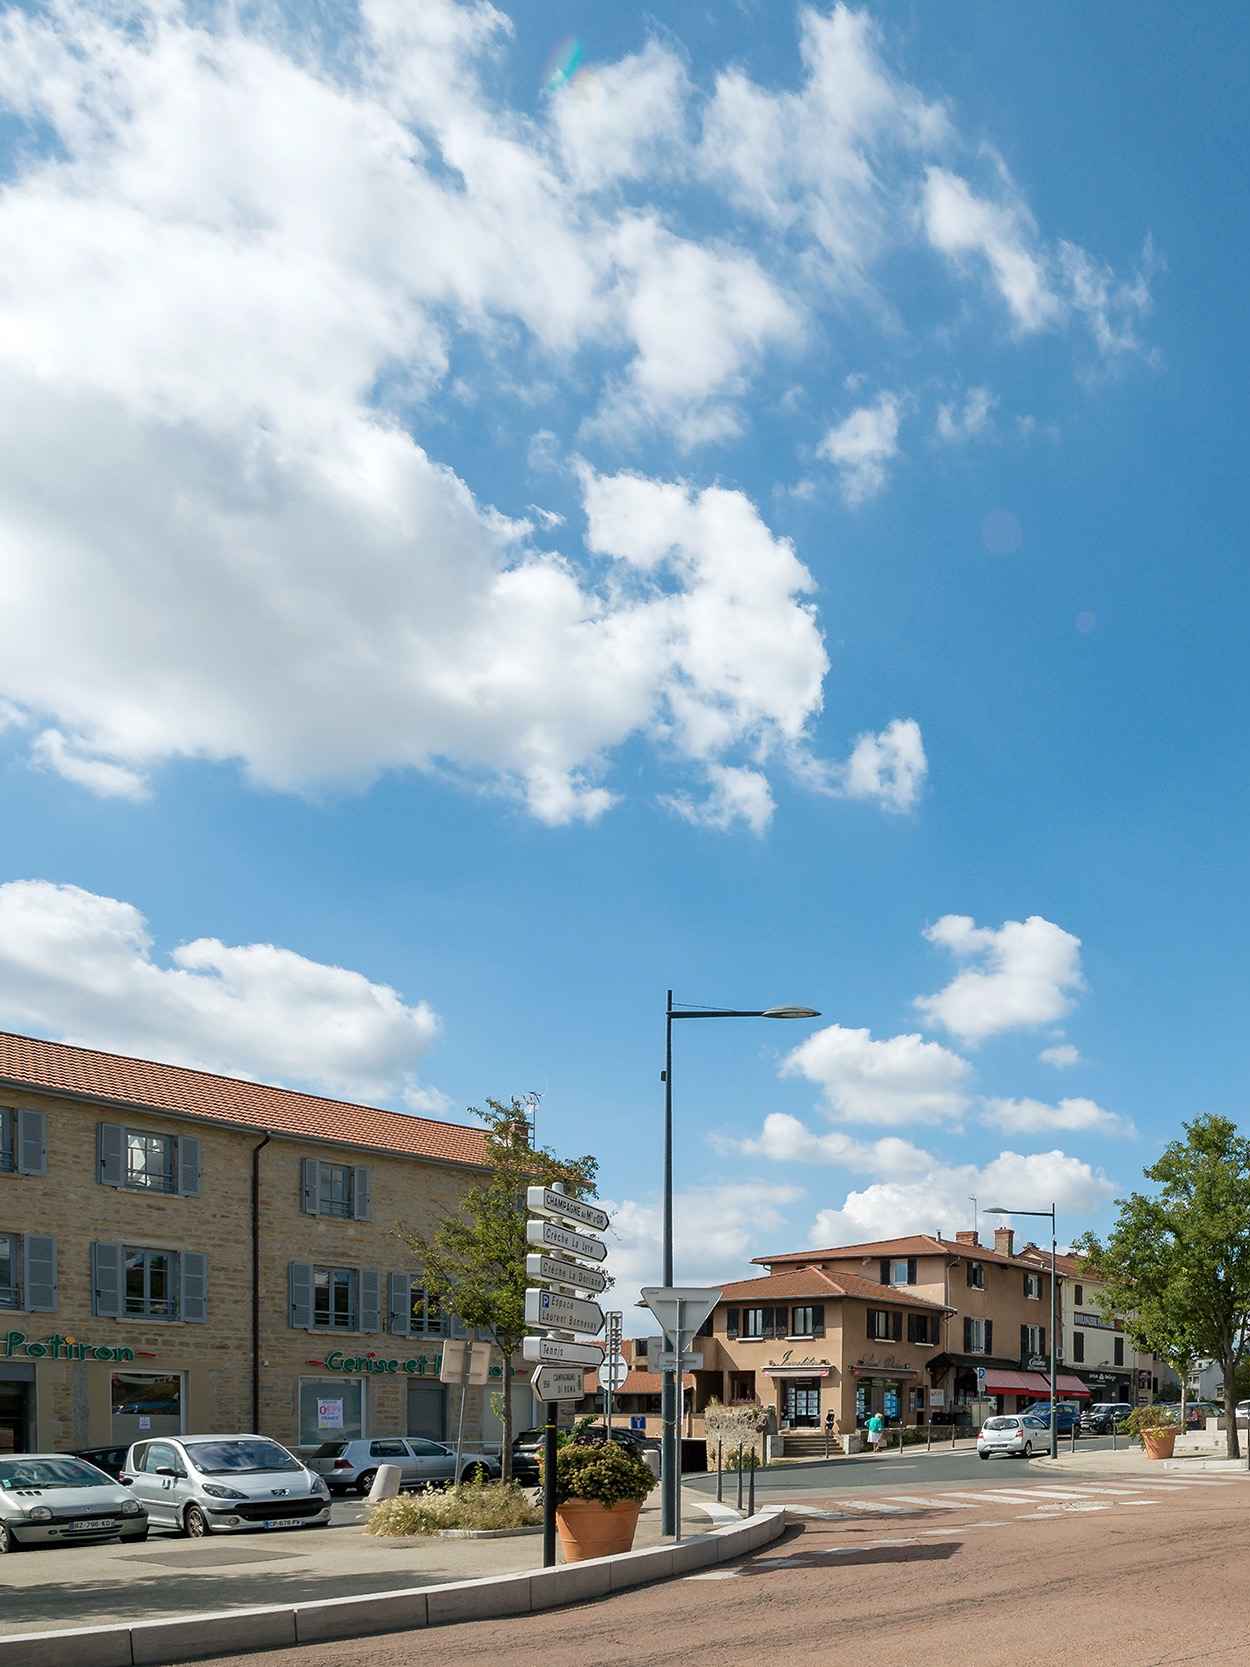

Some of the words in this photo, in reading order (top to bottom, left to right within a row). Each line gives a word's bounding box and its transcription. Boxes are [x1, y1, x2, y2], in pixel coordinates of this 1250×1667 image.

[546, 1194, 581, 1216] CHAMPAGNE
[571, 1240, 579, 1249] La
[568, 1270, 576, 1280] La
[551, 1295, 574, 1310] Espace
[542, 1312, 567, 1324] Laurent
[7, 1329, 135, 1360] Potiron
[543, 1343, 564, 1357] Tennis
[325, 1350, 399, 1374] Cerise
[404, 1354, 431, 1376] et
